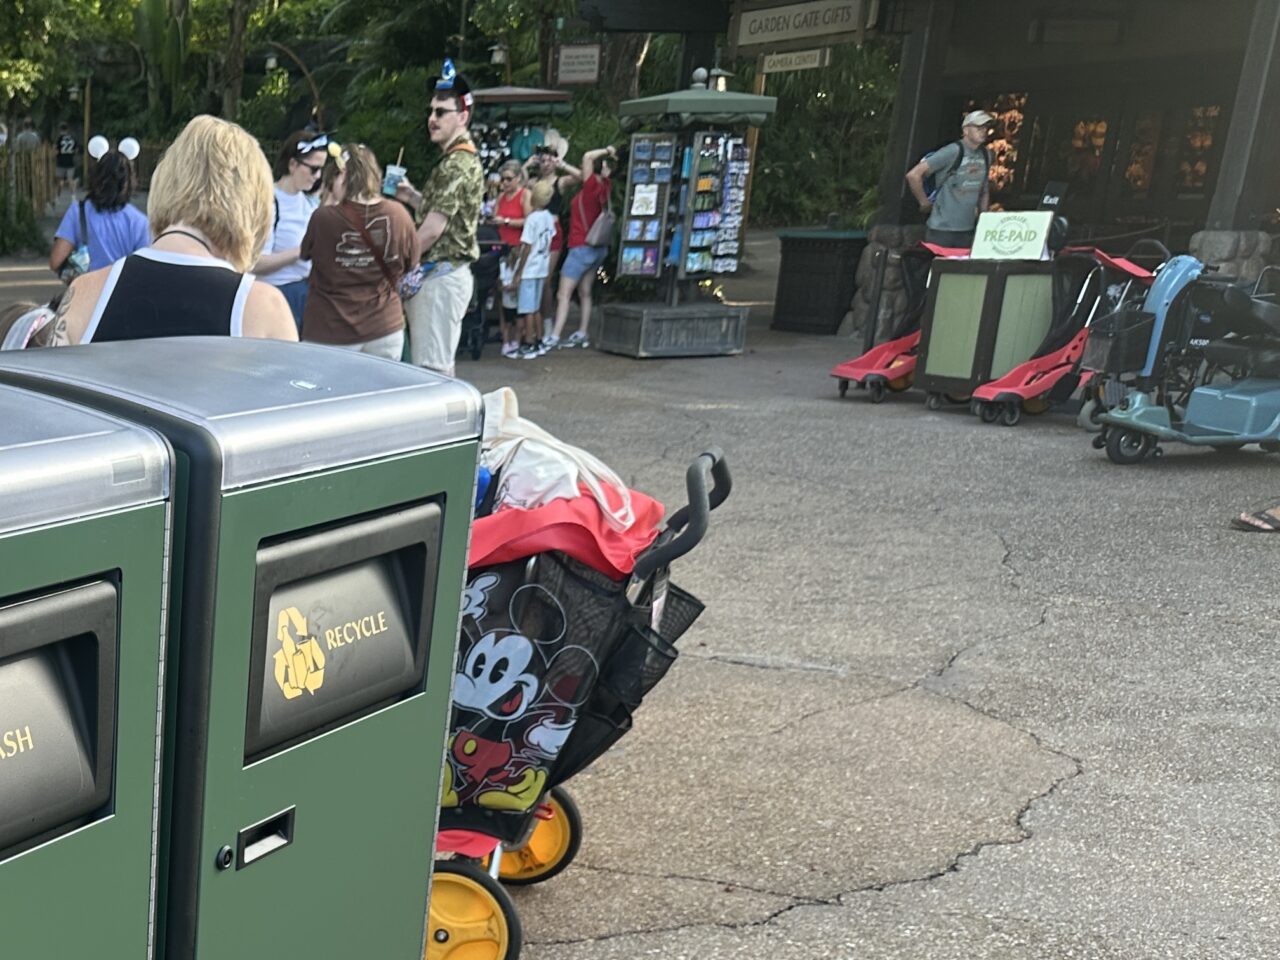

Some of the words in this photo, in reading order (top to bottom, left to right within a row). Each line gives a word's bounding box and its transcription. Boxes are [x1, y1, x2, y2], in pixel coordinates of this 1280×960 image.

[748, 14, 790, 36] GARDEN
[792, 10, 820, 29] GATE
[822, 5, 852, 25] GIFTS
[767, 56, 793, 69] CAMERA
[794, 52, 818, 67] CENTER
[60, 138, 75, 155] 22
[1042, 195, 1060, 205] Exit
[983, 229, 1038, 242] PRE-PAID
[324, 611, 388, 651] RECYCLE
